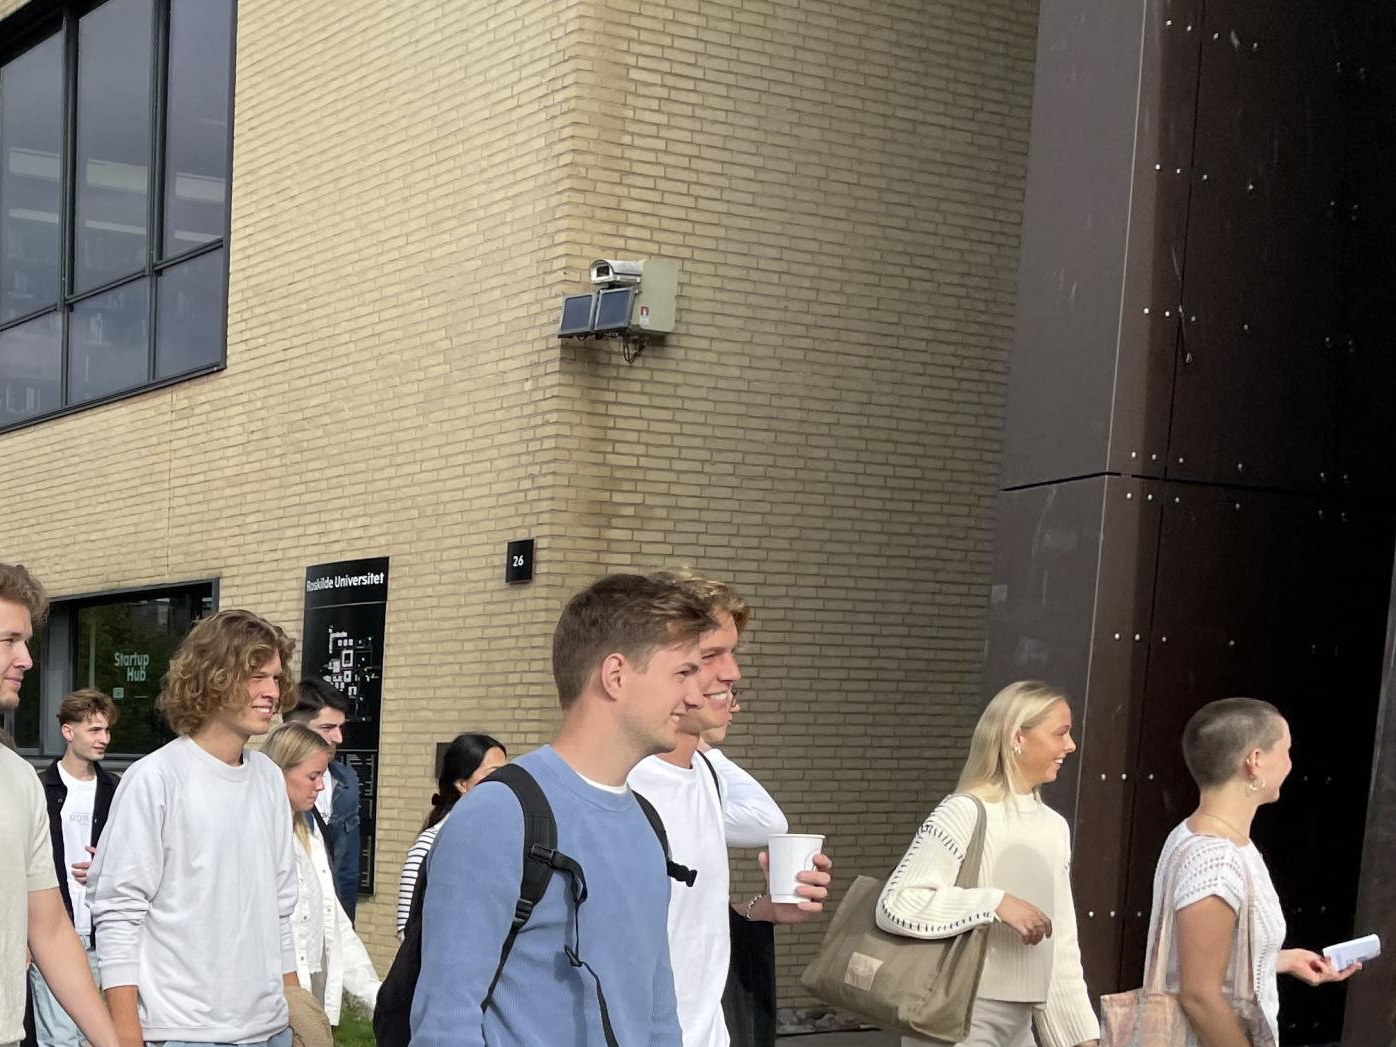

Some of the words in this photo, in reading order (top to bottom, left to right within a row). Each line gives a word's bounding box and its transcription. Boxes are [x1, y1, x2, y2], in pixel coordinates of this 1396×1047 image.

[513, 554, 524, 567] 26
[306, 576, 334, 592] Roskilde
[334, 572, 385, 588] Universitet
[114, 652, 150, 670] Startup
[126, 666, 146, 682] Hub
[68, 814, 92, 823] NOR
